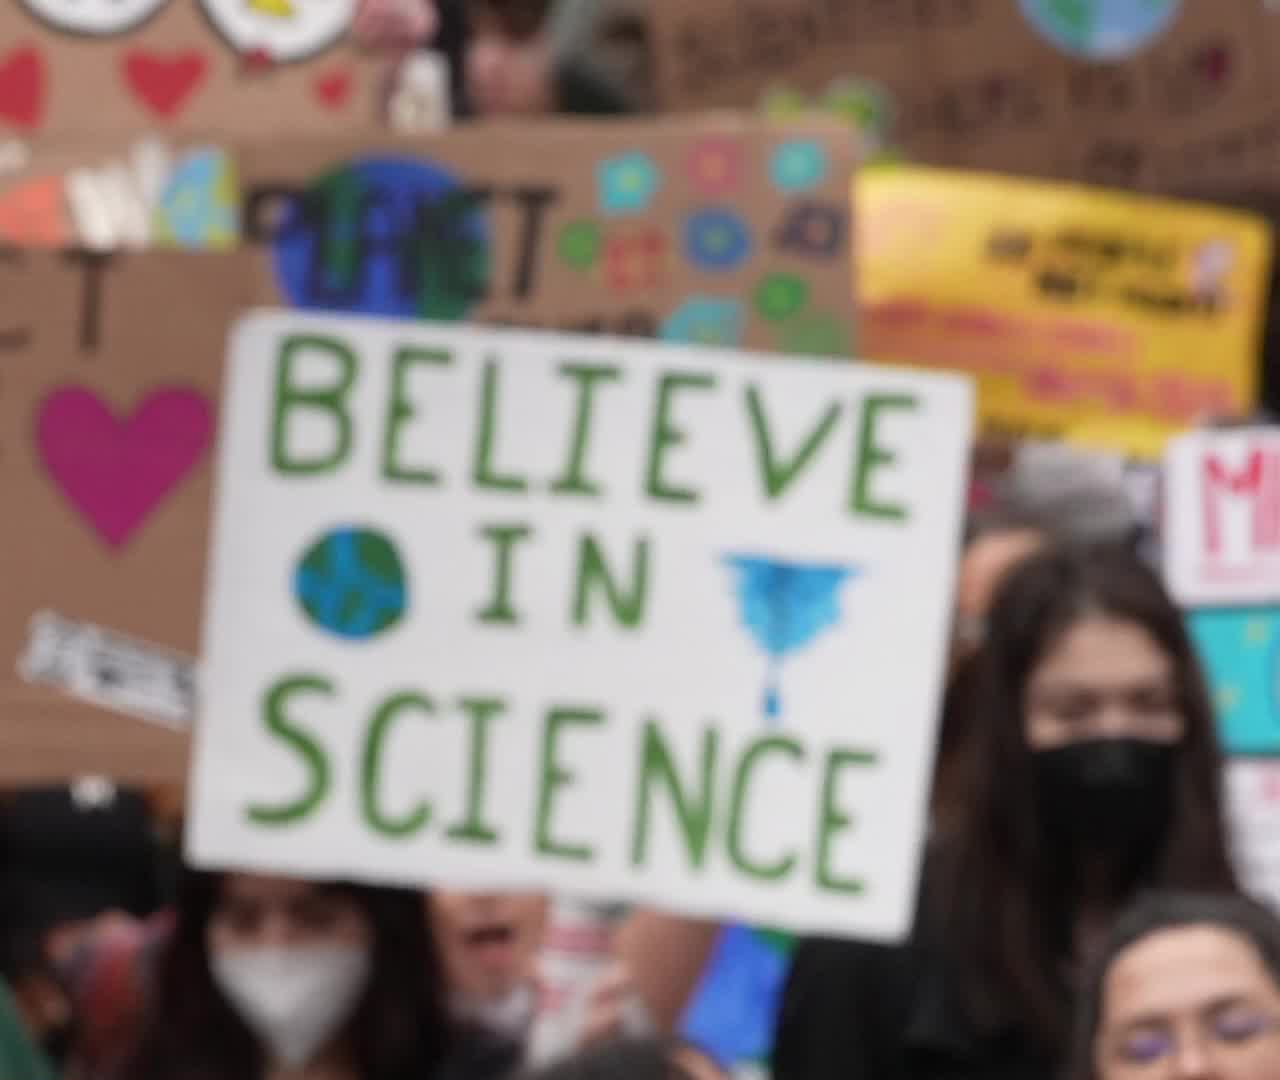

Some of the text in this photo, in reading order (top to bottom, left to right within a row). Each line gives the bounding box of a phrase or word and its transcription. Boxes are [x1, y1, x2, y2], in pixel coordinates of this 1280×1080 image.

[267, 332, 922, 522] BELIEVE
[472, 522, 654, 632] IN
[243, 672, 880, 898] SCIENCE
